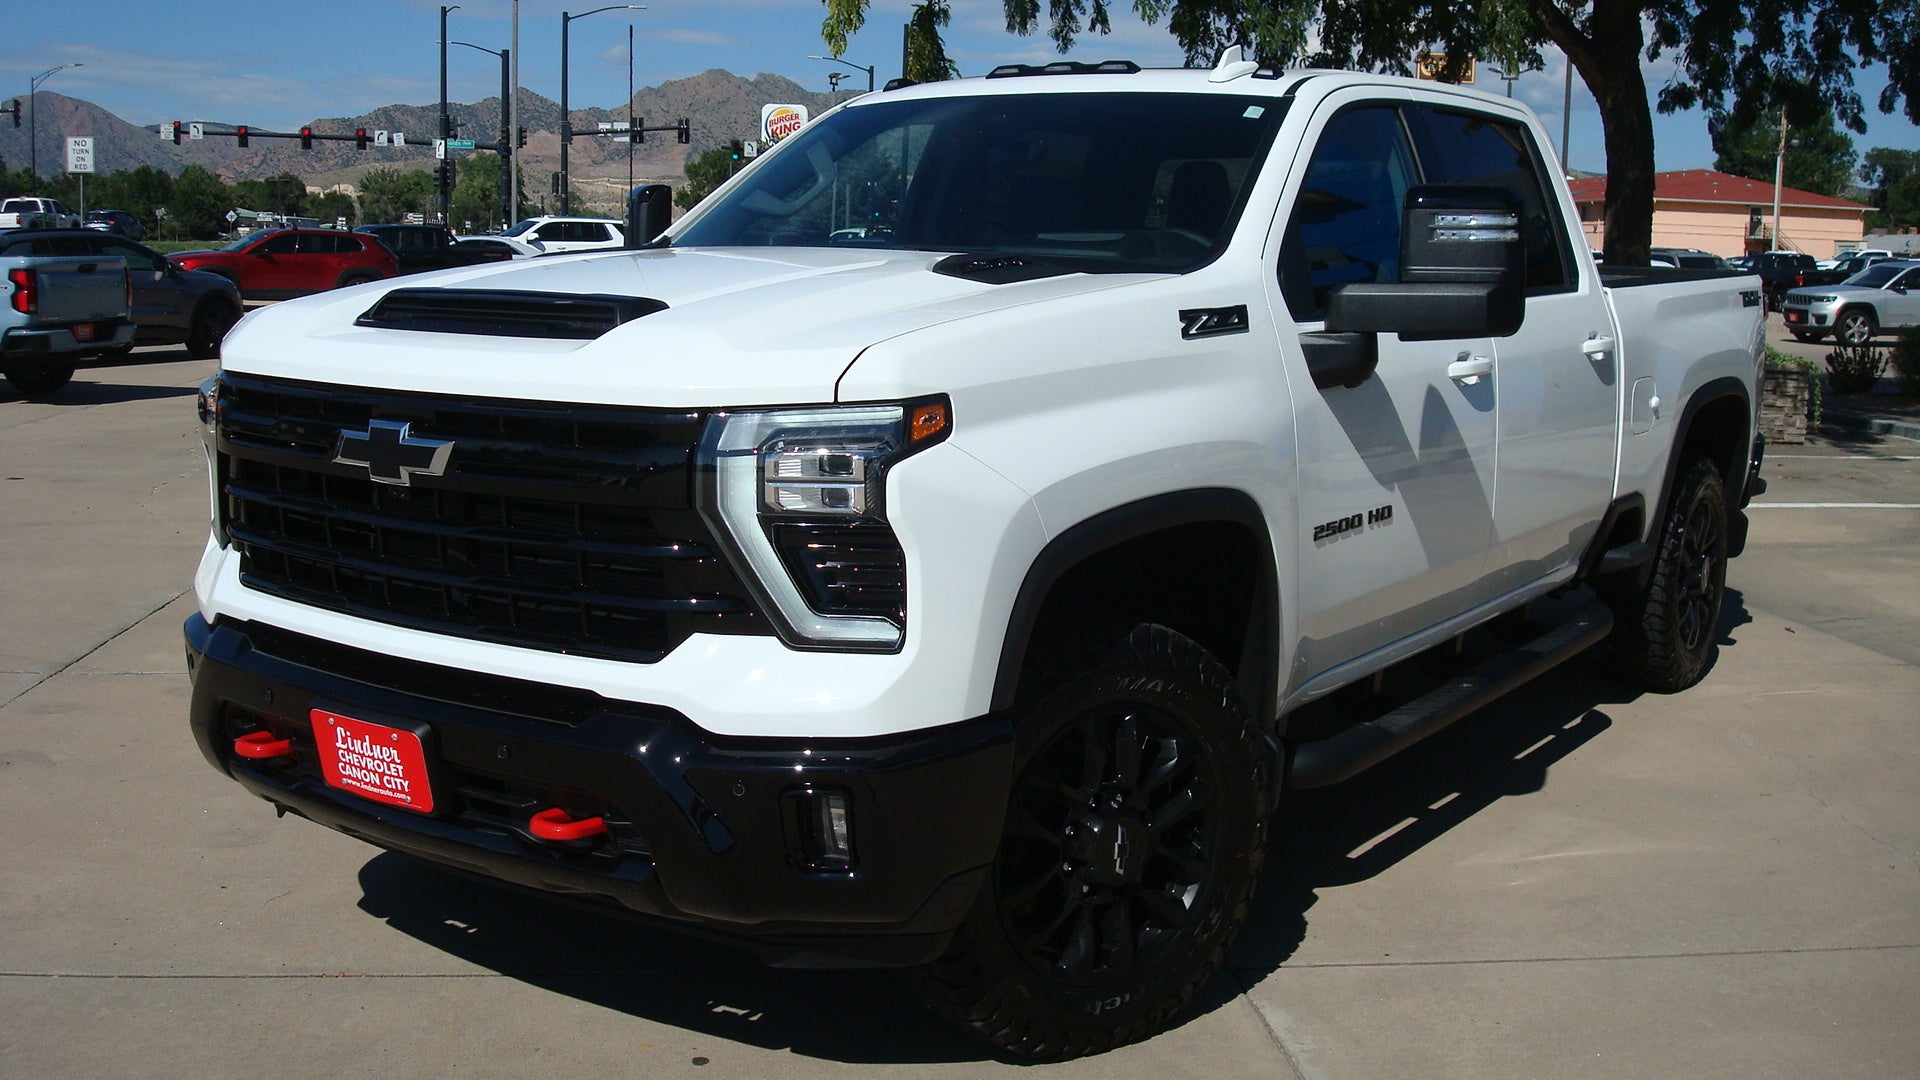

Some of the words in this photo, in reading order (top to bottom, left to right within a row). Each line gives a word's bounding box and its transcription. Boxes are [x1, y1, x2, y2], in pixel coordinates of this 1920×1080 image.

[769, 113, 800, 128] BURGER
[770, 121, 801, 138] KING
[1313, 513, 1363, 542] 2500
[1367, 504, 1393, 525] HD
[336, 726, 401, 763] Lindner
[338, 749, 404, 778] CHEVROLET
[338, 762, 381, 786] CANON
[383, 775, 410, 793] CITY
